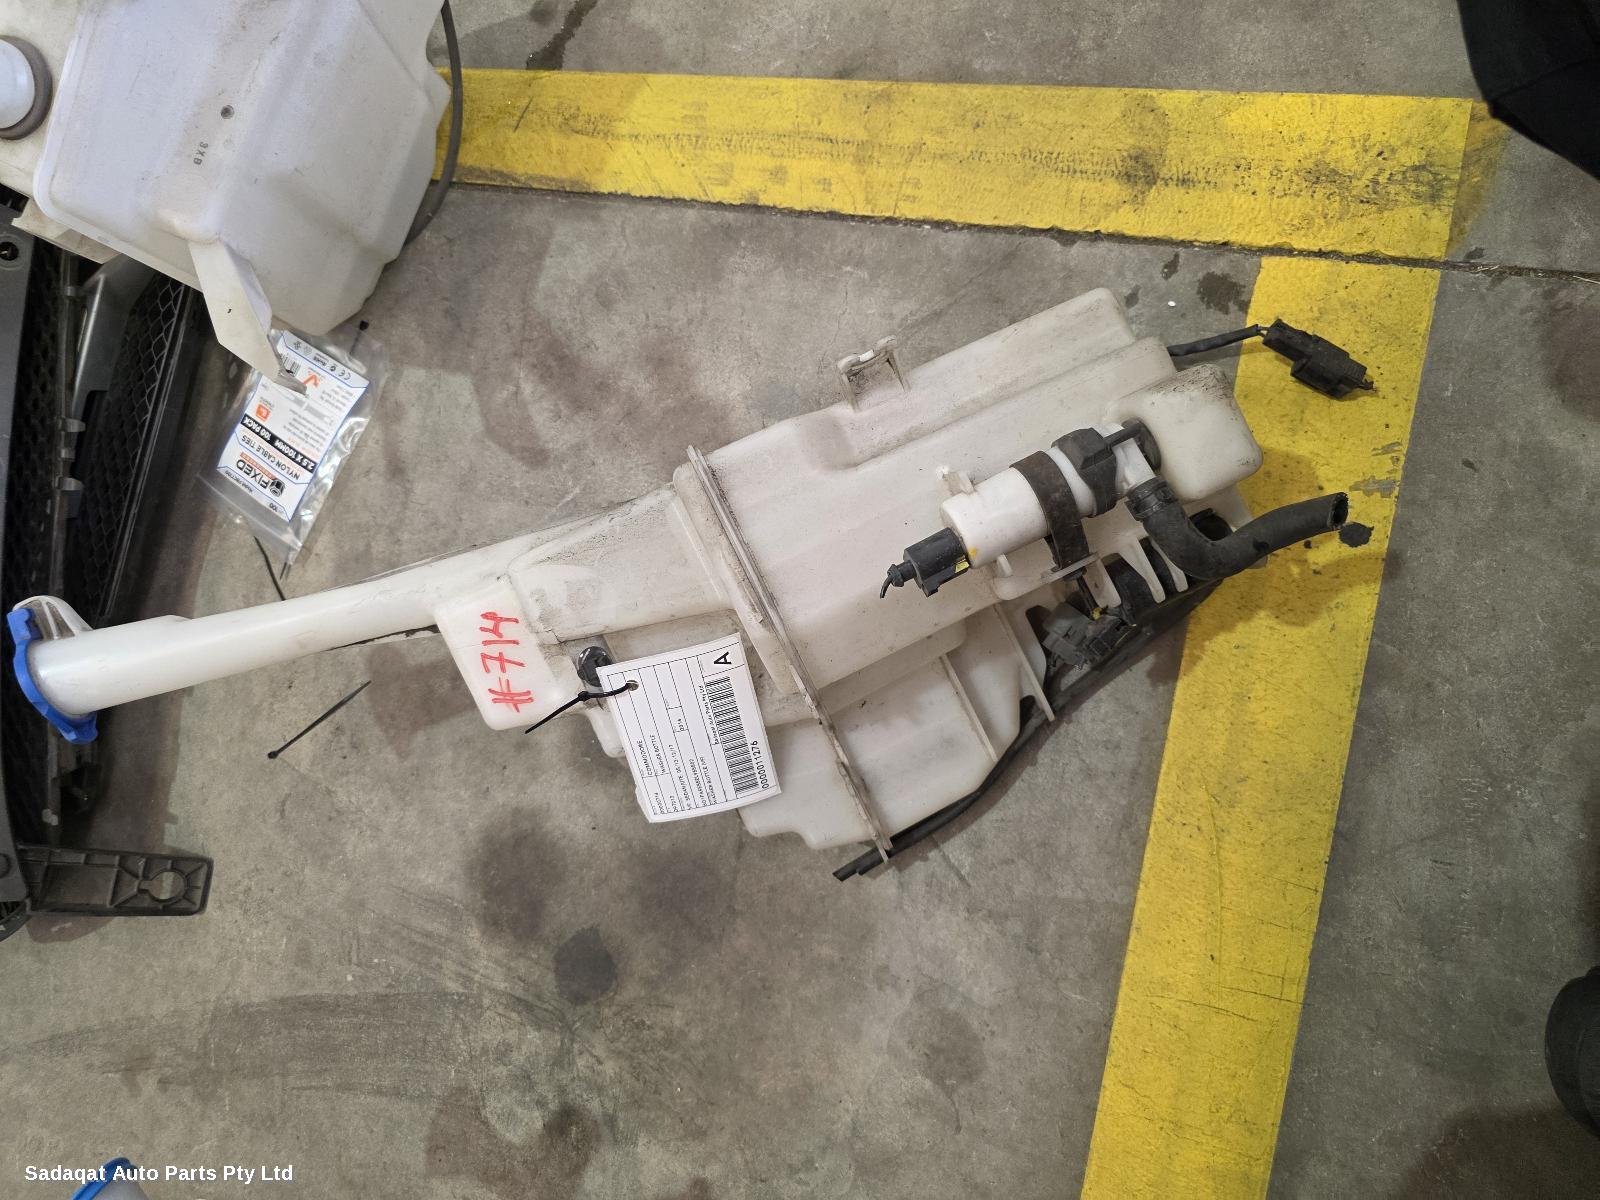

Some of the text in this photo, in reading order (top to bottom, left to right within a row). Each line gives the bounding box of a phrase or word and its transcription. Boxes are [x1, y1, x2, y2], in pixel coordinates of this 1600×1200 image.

[242, 416, 261, 432] PACK
[240, 434, 256, 447] TIES
[259, 428, 272, 440] 100
[255, 445, 276, 462] CABLE
[273, 438, 297, 458] 100MM
[294, 453, 303, 462] X
[301, 457, 315, 470] 2.5
[233, 457, 271, 489] FIXED
[275, 459, 300, 480] NYLON
[714, 652, 732, 667] A
[649, 733, 659, 752] BOTTLE
[636, 739, 653, 775] COMMODORE
[751, 741, 769, 788] 0000011276
